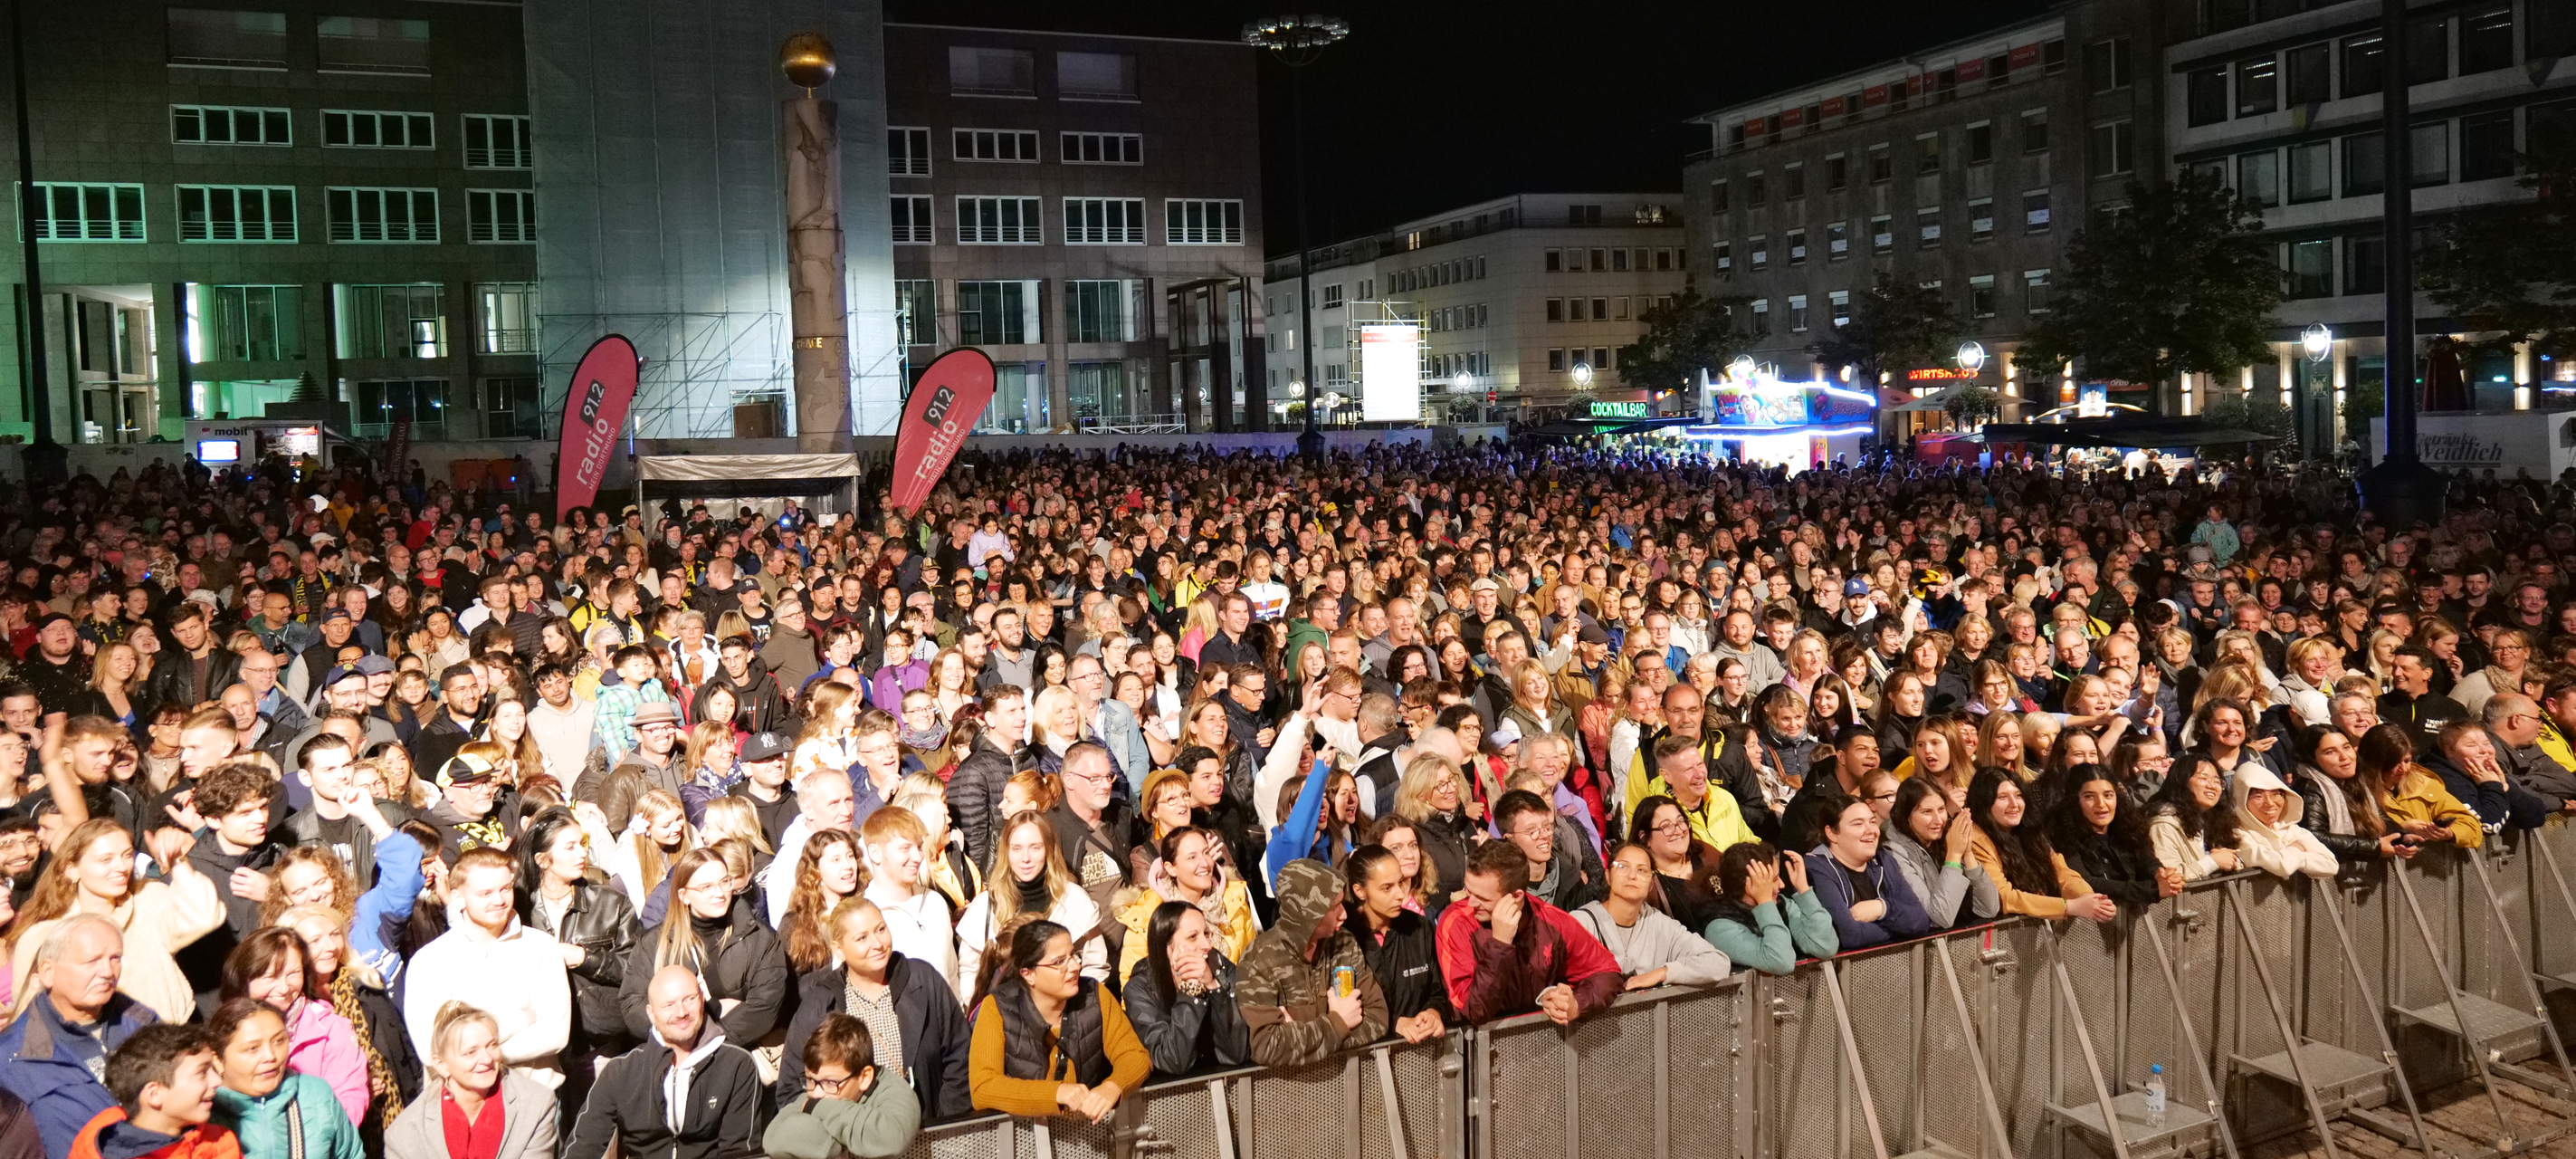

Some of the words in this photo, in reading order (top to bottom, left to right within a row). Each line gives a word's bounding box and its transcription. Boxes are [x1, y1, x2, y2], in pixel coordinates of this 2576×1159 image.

[2110, 378, 2131, 387] Orizo
[584, 383, 606, 418] 91.2
[928, 388, 956, 421] 91.2
[2417, 432, 2478, 446] Getränke
[577, 418, 608, 485] radio
[589, 472, 599, 490] MEIN
[596, 427, 616, 470] DORTMUND
[915, 420, 957, 479] radio
[929, 465, 941, 484] MEIN
[941, 428, 966, 465] DORTMUND
[2417, 442, 2503, 461] Weidlich
[761, 733, 778, 748] NY
[1080, 858, 1106, 876] ORTH
[1084, 851, 1103, 865] THE
[1083, 868, 1107, 884] FACE
